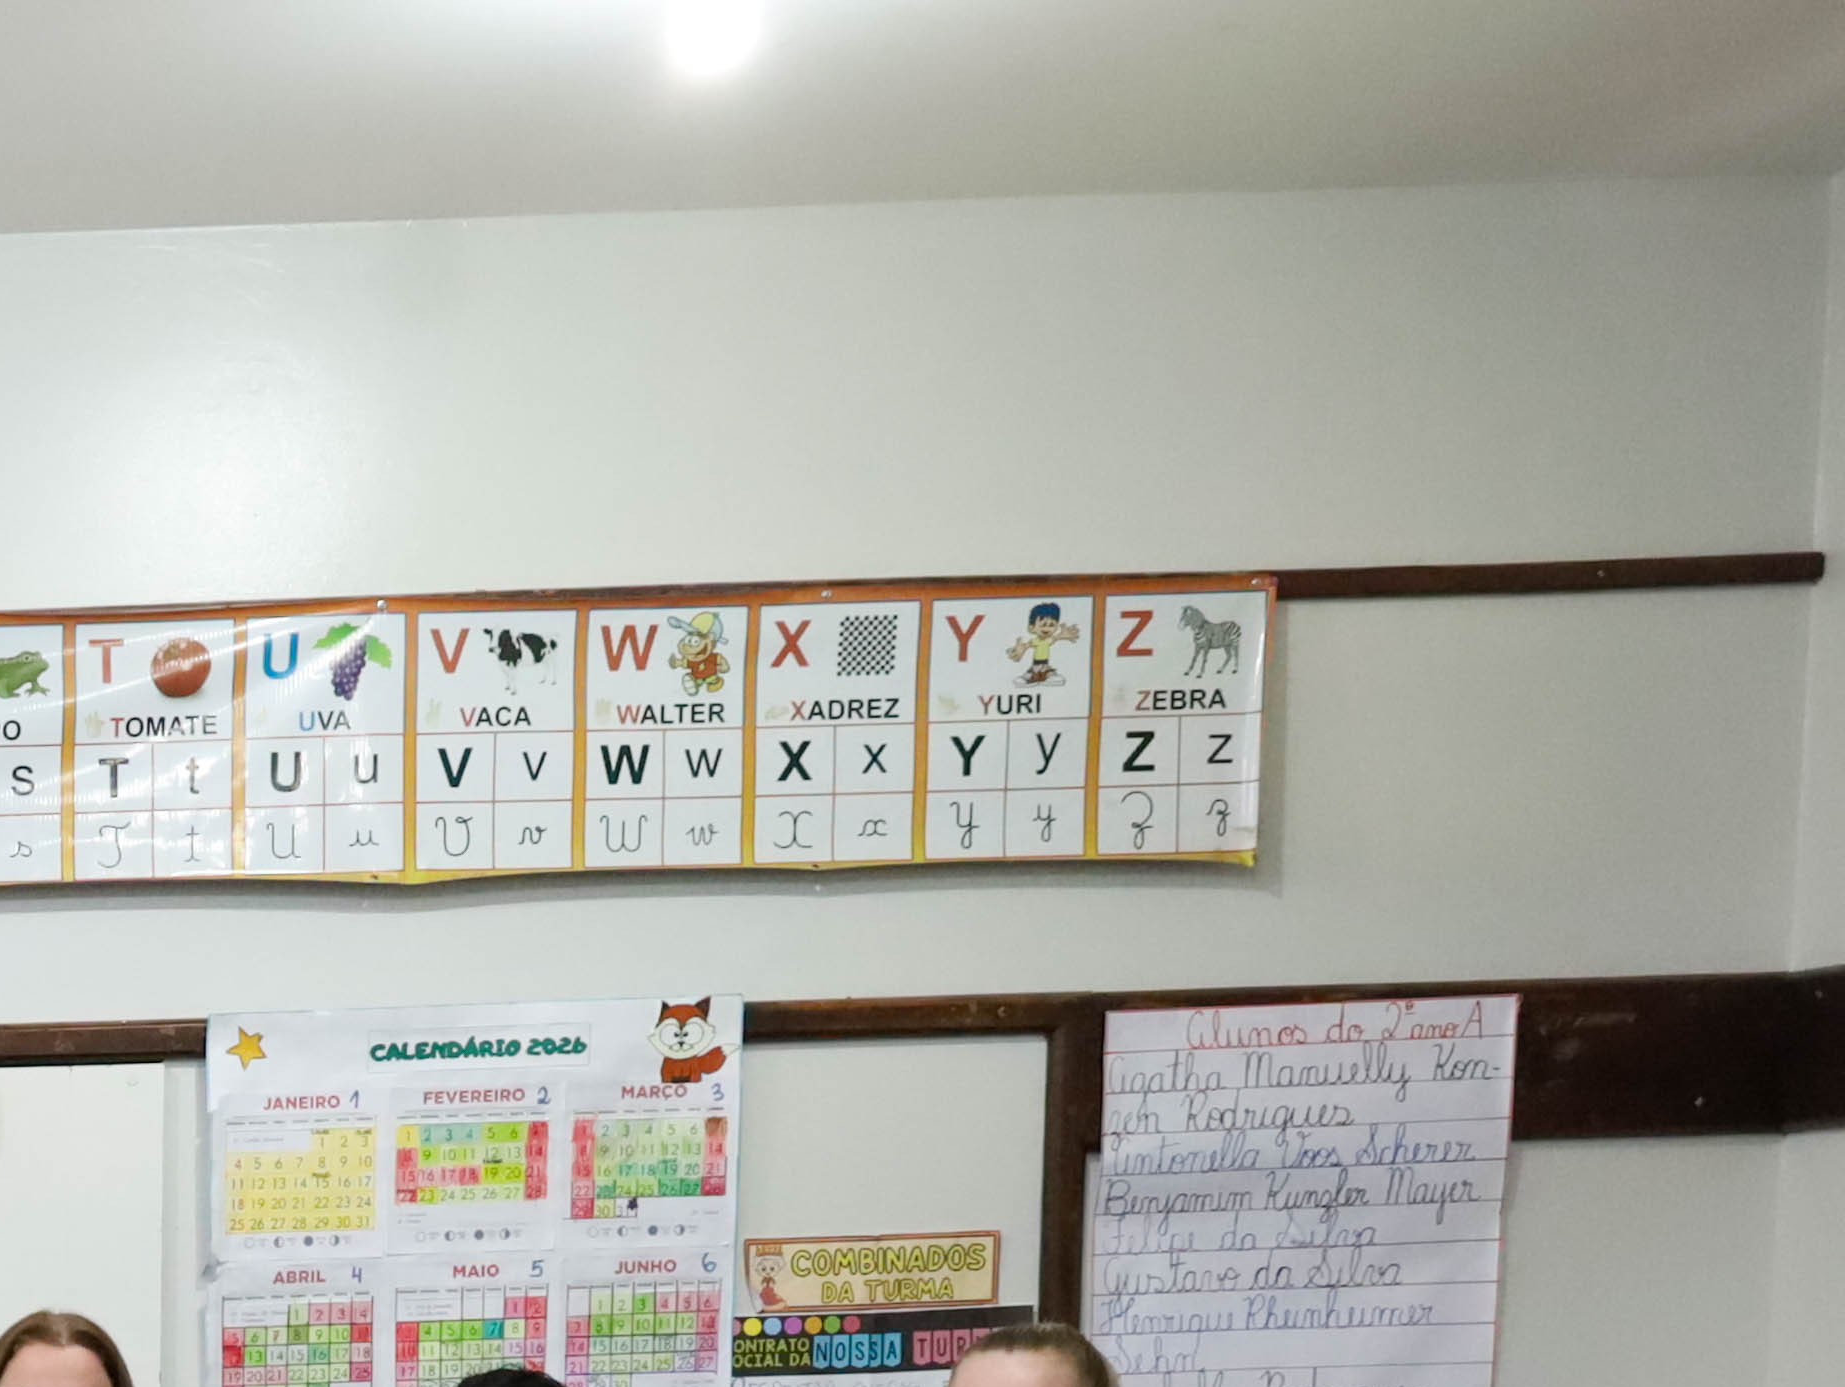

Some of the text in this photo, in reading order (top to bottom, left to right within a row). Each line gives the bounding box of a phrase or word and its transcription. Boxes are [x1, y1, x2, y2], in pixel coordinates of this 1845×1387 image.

[771, 620, 812, 668] X
[947, 615, 986, 663] Y
[1117, 610, 1154, 658] Z
[263, 633, 298, 680] U
[431, 627, 470, 674] V
[600, 624, 659, 672] W
[89, 639, 126, 684] T
[789, 697, 900, 722] XADREZ
[979, 693, 1043, 717] YURI
[1135, 687, 1226, 713] ZEBRA
[299, 710, 351, 733] UVA
[461, 704, 532, 728] VACA
[617, 701, 725, 725] WALTER
[111, 713, 218, 740] TOMATE
[1187, 1010, 1308, 1048] Alunos
[1324, 1003, 1363, 1042] do
[370, 1037, 587, 1062] CALENDÁRIO 2026
[264, 1095, 340, 1110] JANEIRO
[423, 1089, 525, 1105] FEVEREIRO
[621, 1084, 687, 1100] MARÇO
[1356, 1124, 1475, 1167] Scherer
[1387, 1167, 1481, 1224] Mayer
[453, 1264, 499, 1279] MAIO
[615, 1259, 677, 1274] JUNHO
[791, 1243, 986, 1277] COMBINADOS
[273, 1270, 325, 1284] ABRIL
[822, 1278, 954, 1303] DA TURMA
[734, 1338, 809, 1353] ONTRATO
[815, 1340, 898, 1361] NOSSA
[733, 1354, 811, 1367] OCIAL DA
